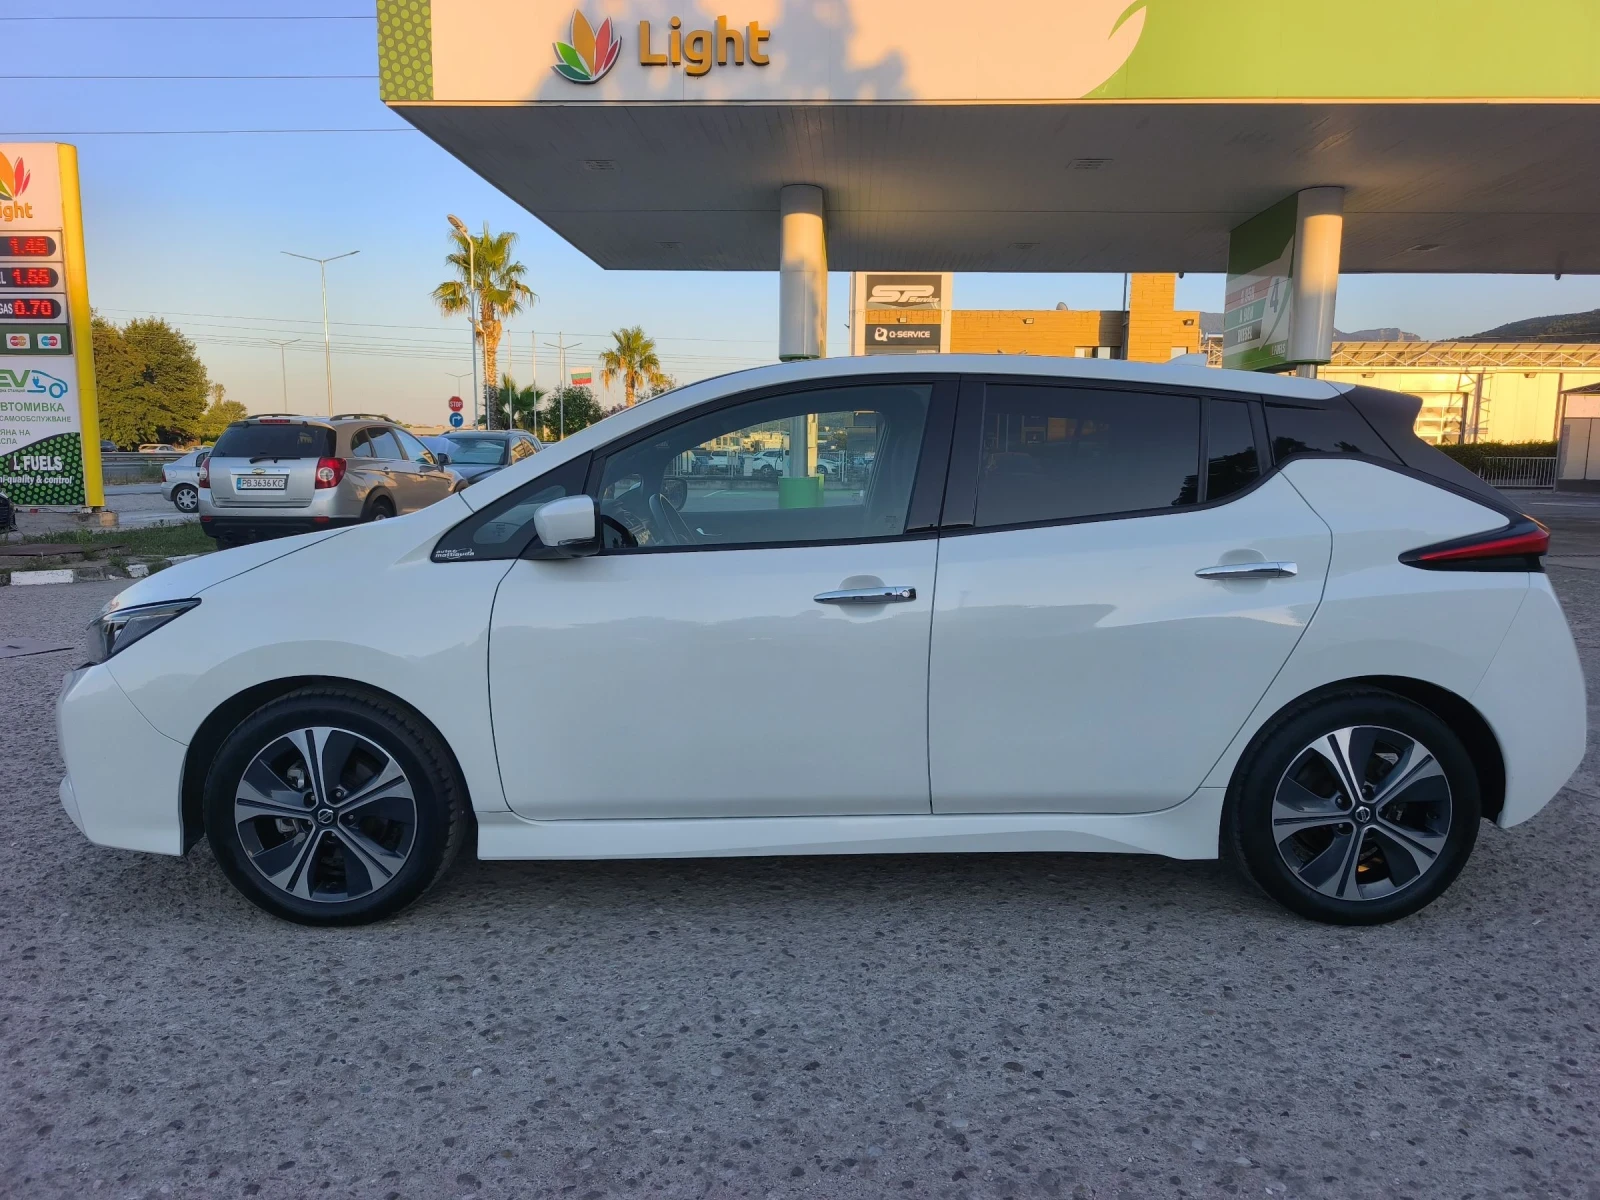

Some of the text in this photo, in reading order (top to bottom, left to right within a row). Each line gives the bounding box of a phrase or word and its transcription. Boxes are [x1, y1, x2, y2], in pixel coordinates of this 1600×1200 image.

[639, 15, 770, 76] Light
[868, 285, 935, 303] SP
[1270, 277, 1280, 313] 4
[14, 300, 52, 315] 0.70
[13, 455, 63, 471] L FUELS
[36, 474, 42, 484] &
[253, 479, 271, 488] 3636
